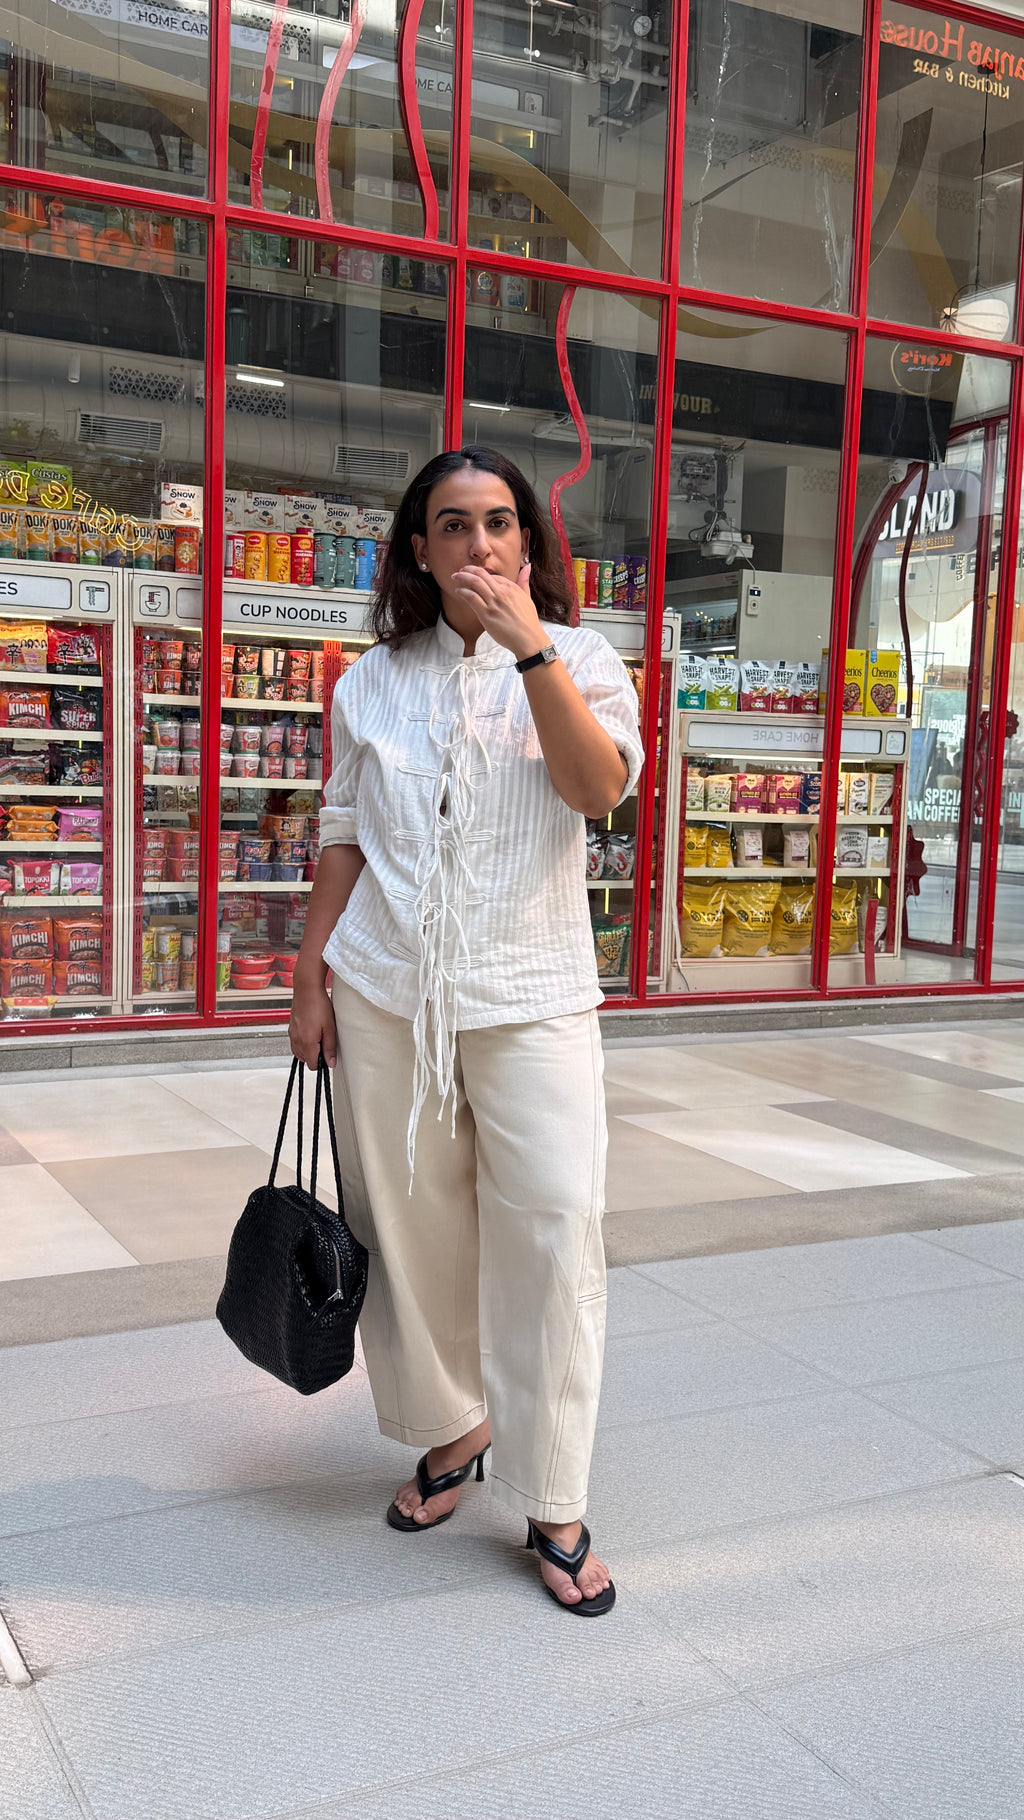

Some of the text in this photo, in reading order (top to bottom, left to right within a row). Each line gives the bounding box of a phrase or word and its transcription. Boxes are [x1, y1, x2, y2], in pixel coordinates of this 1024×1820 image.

[138, 10, 208, 36] HOME CAR
[31, 467, 68, 481] Custas
[240, 603, 348, 624] CUP NOODLES
[773, 670, 794, 678] ARVEST
[871, 667, 897, 678] Cheerios
[8, 702, 46, 717] KIMCHI
[60, 709, 97, 722] SUPER
[65, 720, 91, 730] SPICY
[924, 805, 960, 823] COFFE
[11, 931, 49, 947] KIMCHI
[69, 938, 101, 952] KIMCH
[10, 973, 46, 989] KIMCHI
